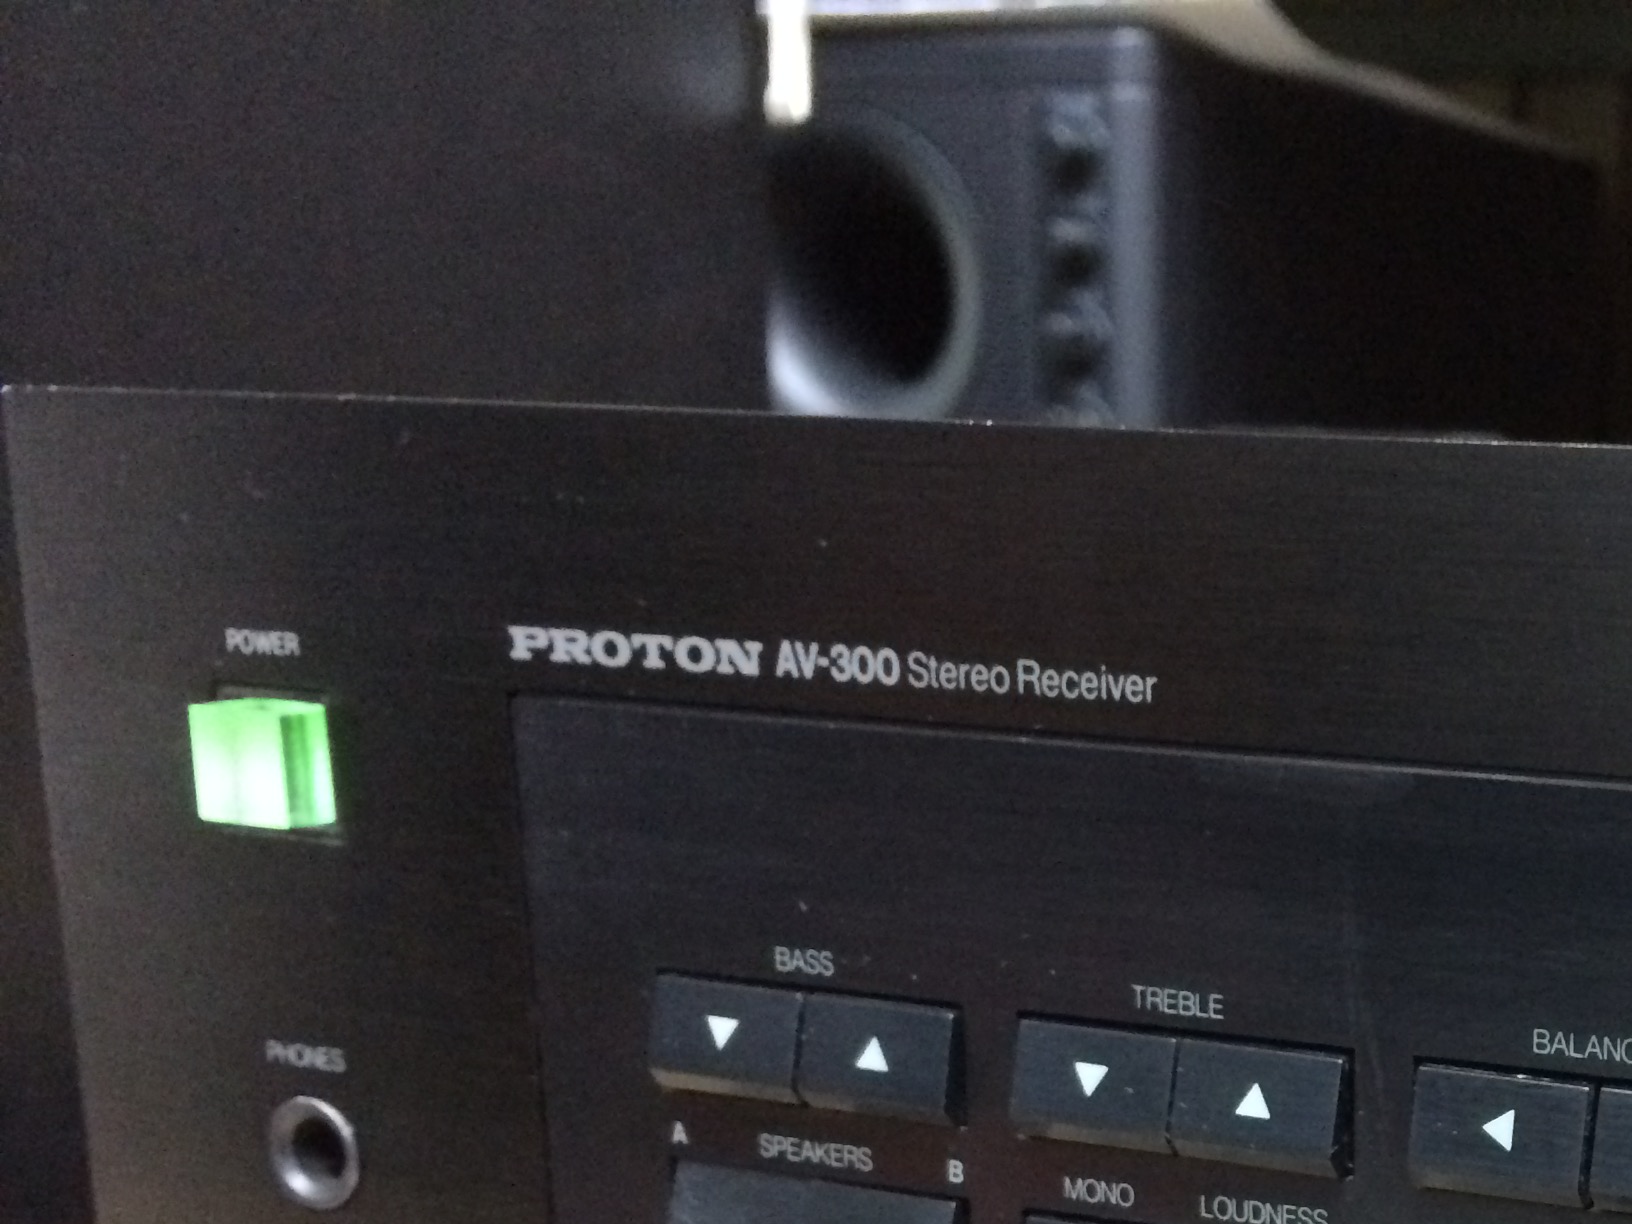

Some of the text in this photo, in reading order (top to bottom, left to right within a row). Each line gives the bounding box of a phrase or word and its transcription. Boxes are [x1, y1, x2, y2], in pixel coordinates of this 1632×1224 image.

[225, 627, 300, 657] POWER
[507, 625, 1157, 703] PROTON AV-300 Stereo Receiver
[774, 946, 835, 976] BASS
[1131, 984, 1224, 1020] TREBLE
[670, 1121, 965, 1182] A SPEAKERS B
[1062, 1176, 1136, 1209] MONO
